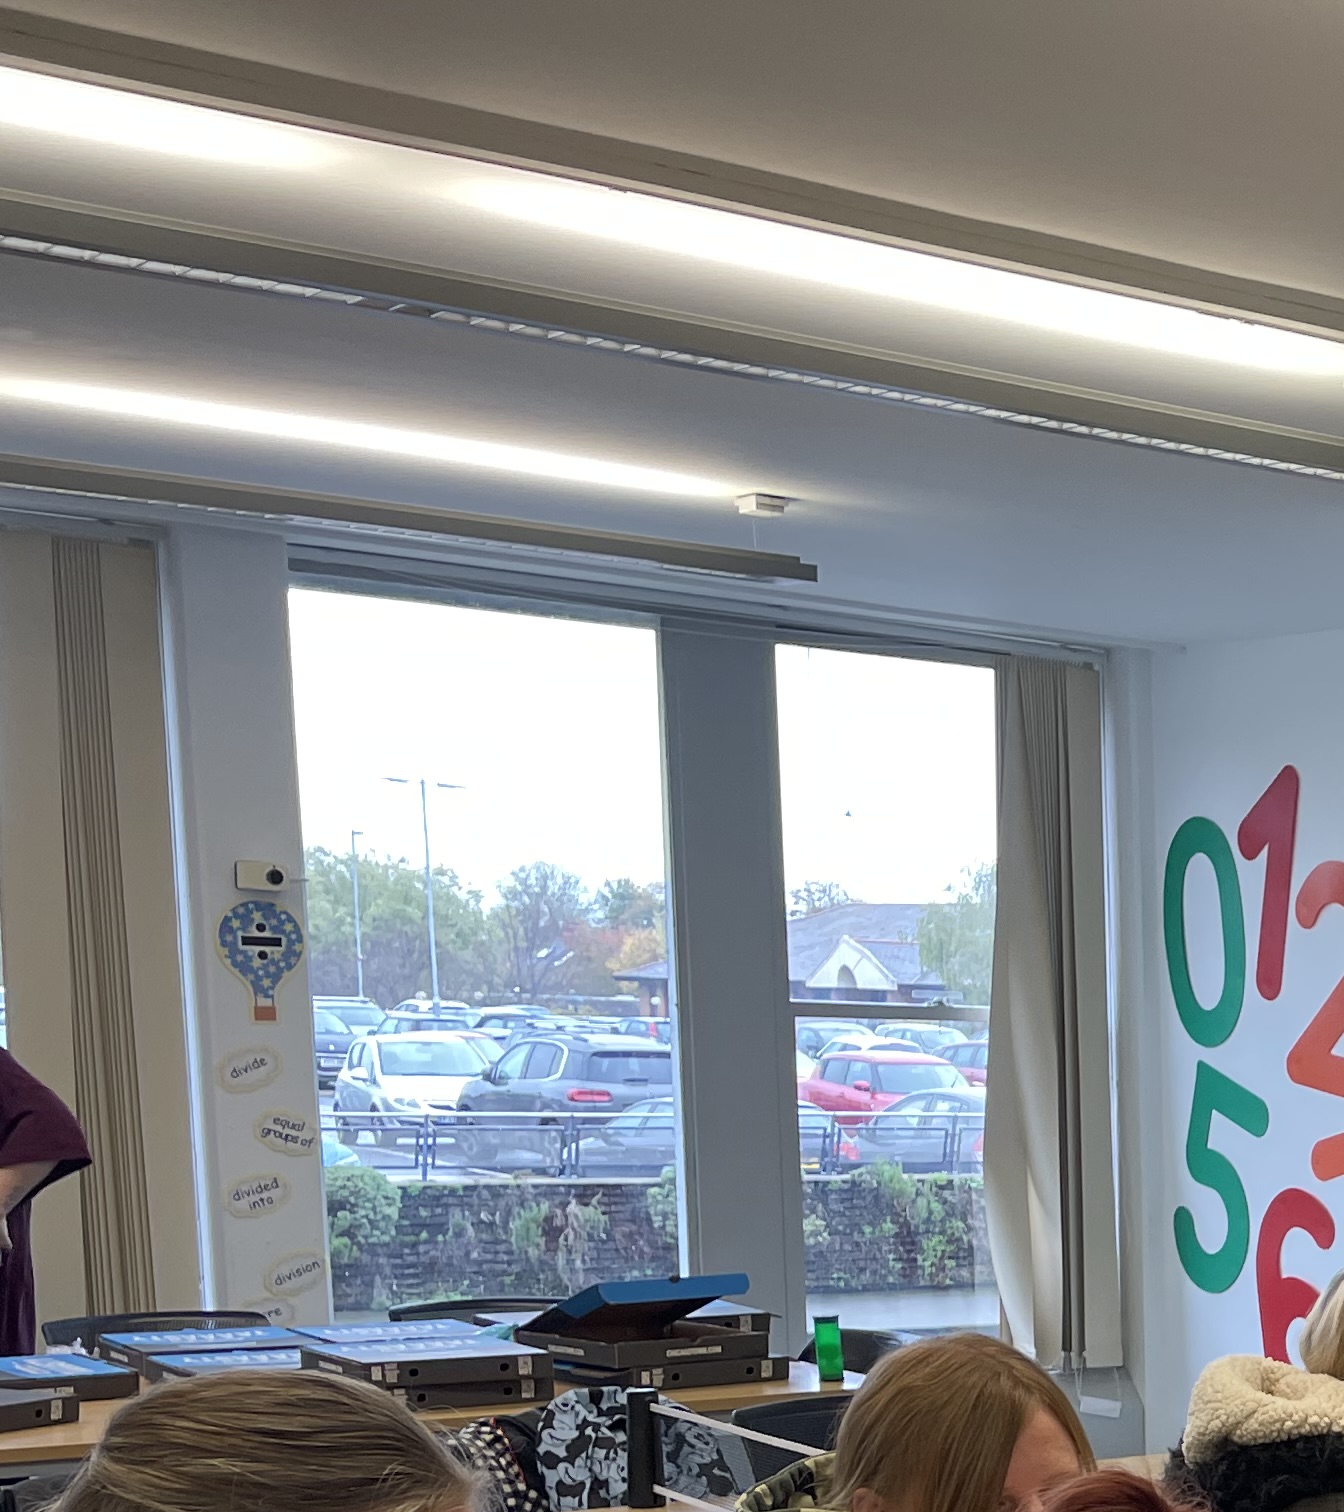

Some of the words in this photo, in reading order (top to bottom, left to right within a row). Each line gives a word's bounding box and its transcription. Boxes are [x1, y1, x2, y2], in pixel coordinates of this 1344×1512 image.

[1164, 816, 1246, 1048] 0
[1238, 764, 1299, 1001] 1
[230, 1057, 267, 1079] divide
[273, 1116, 304, 1132] equal
[232, 1177, 279, 1201] divided
[249, 1196, 274, 1210] into
[1174, 1059, 1269, 1294] 5
[1256, 1188, 1335, 1365] 6
[275, 1260, 320, 1286] division
